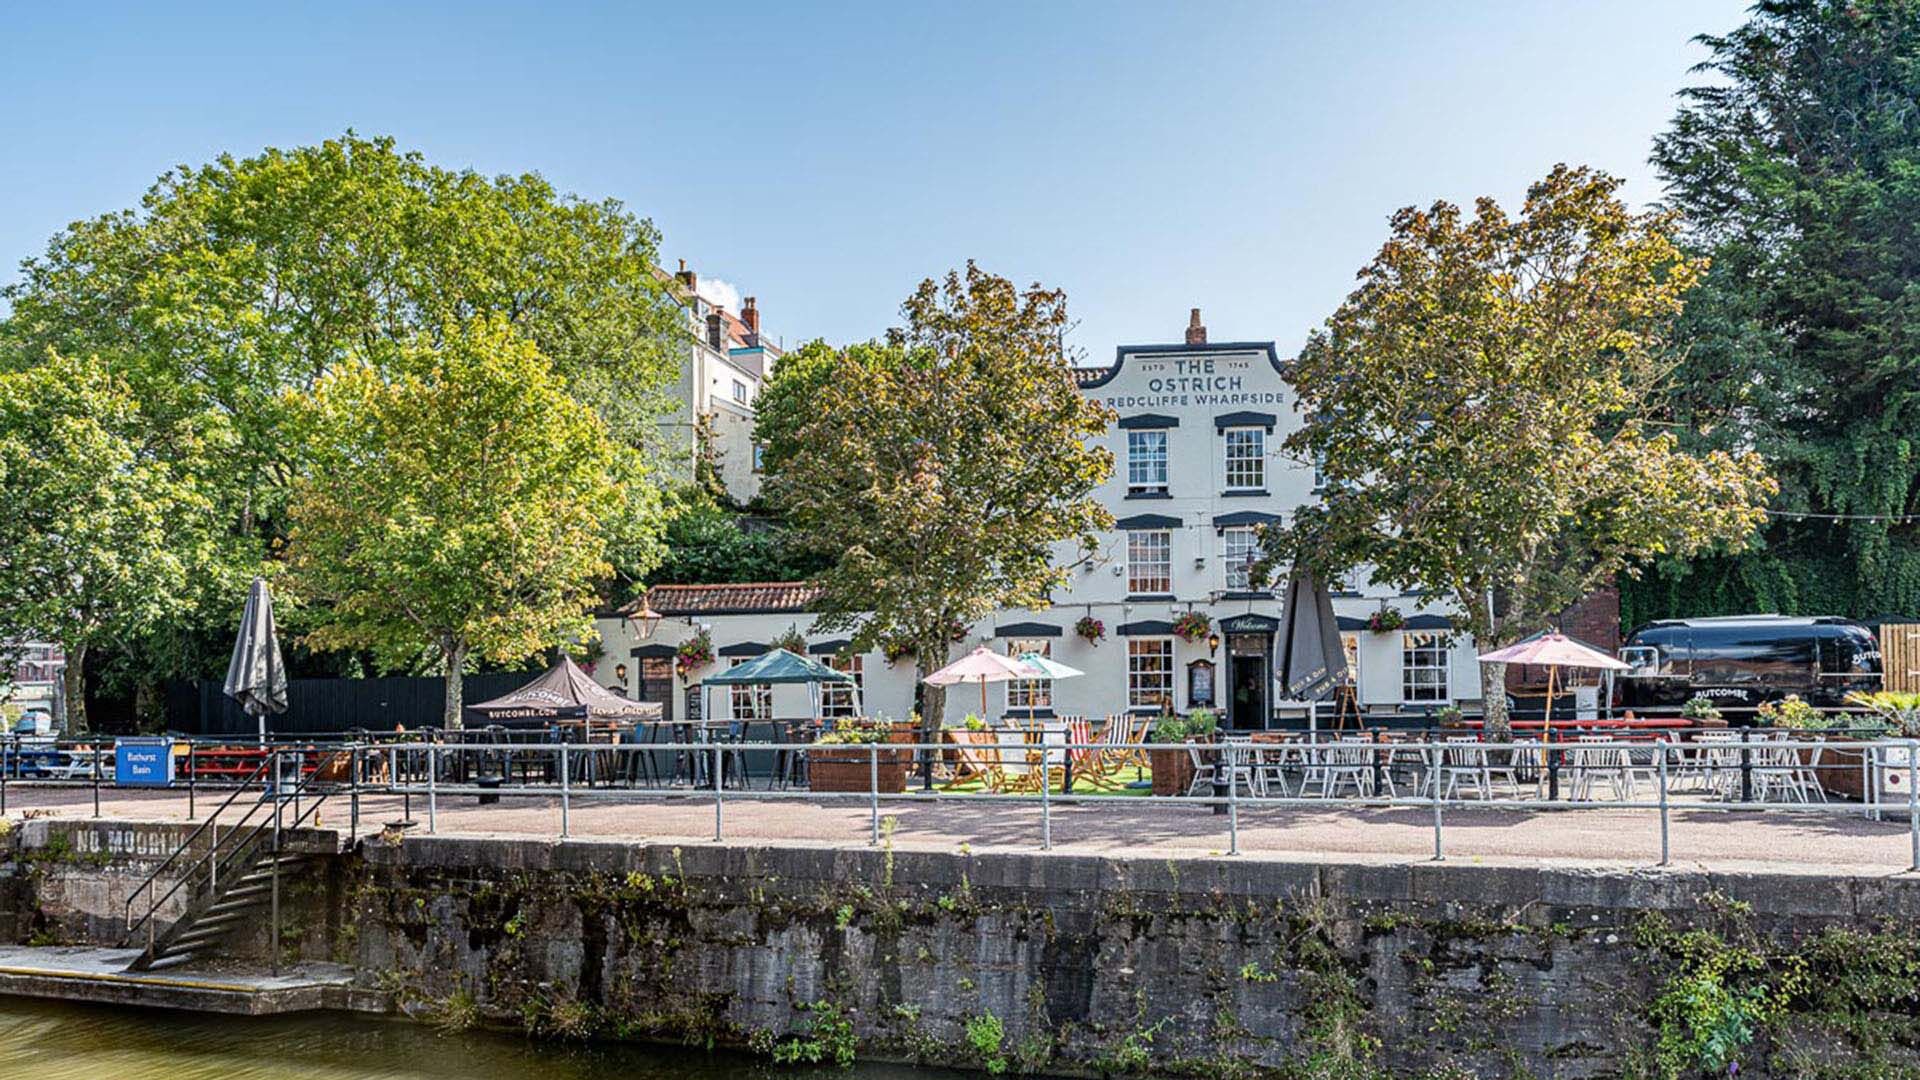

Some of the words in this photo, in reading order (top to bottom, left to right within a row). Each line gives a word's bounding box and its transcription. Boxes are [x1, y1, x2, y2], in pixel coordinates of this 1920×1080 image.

[1175, 359, 1215, 375] THE
[1149, 376, 1242, 392] OSTRICH
[1107, 395, 1188, 408] REDCLIFFE
[1195, 392, 1284, 405] WHARFSIDE
[1694, 688, 1748, 701] BUTCOMBE
[489, 708, 558, 718] BUTCOMBE.COM
[127, 752, 156, 762] Bathurst
[132, 765, 151, 774] Basin
[77, 830, 100, 853] NO
